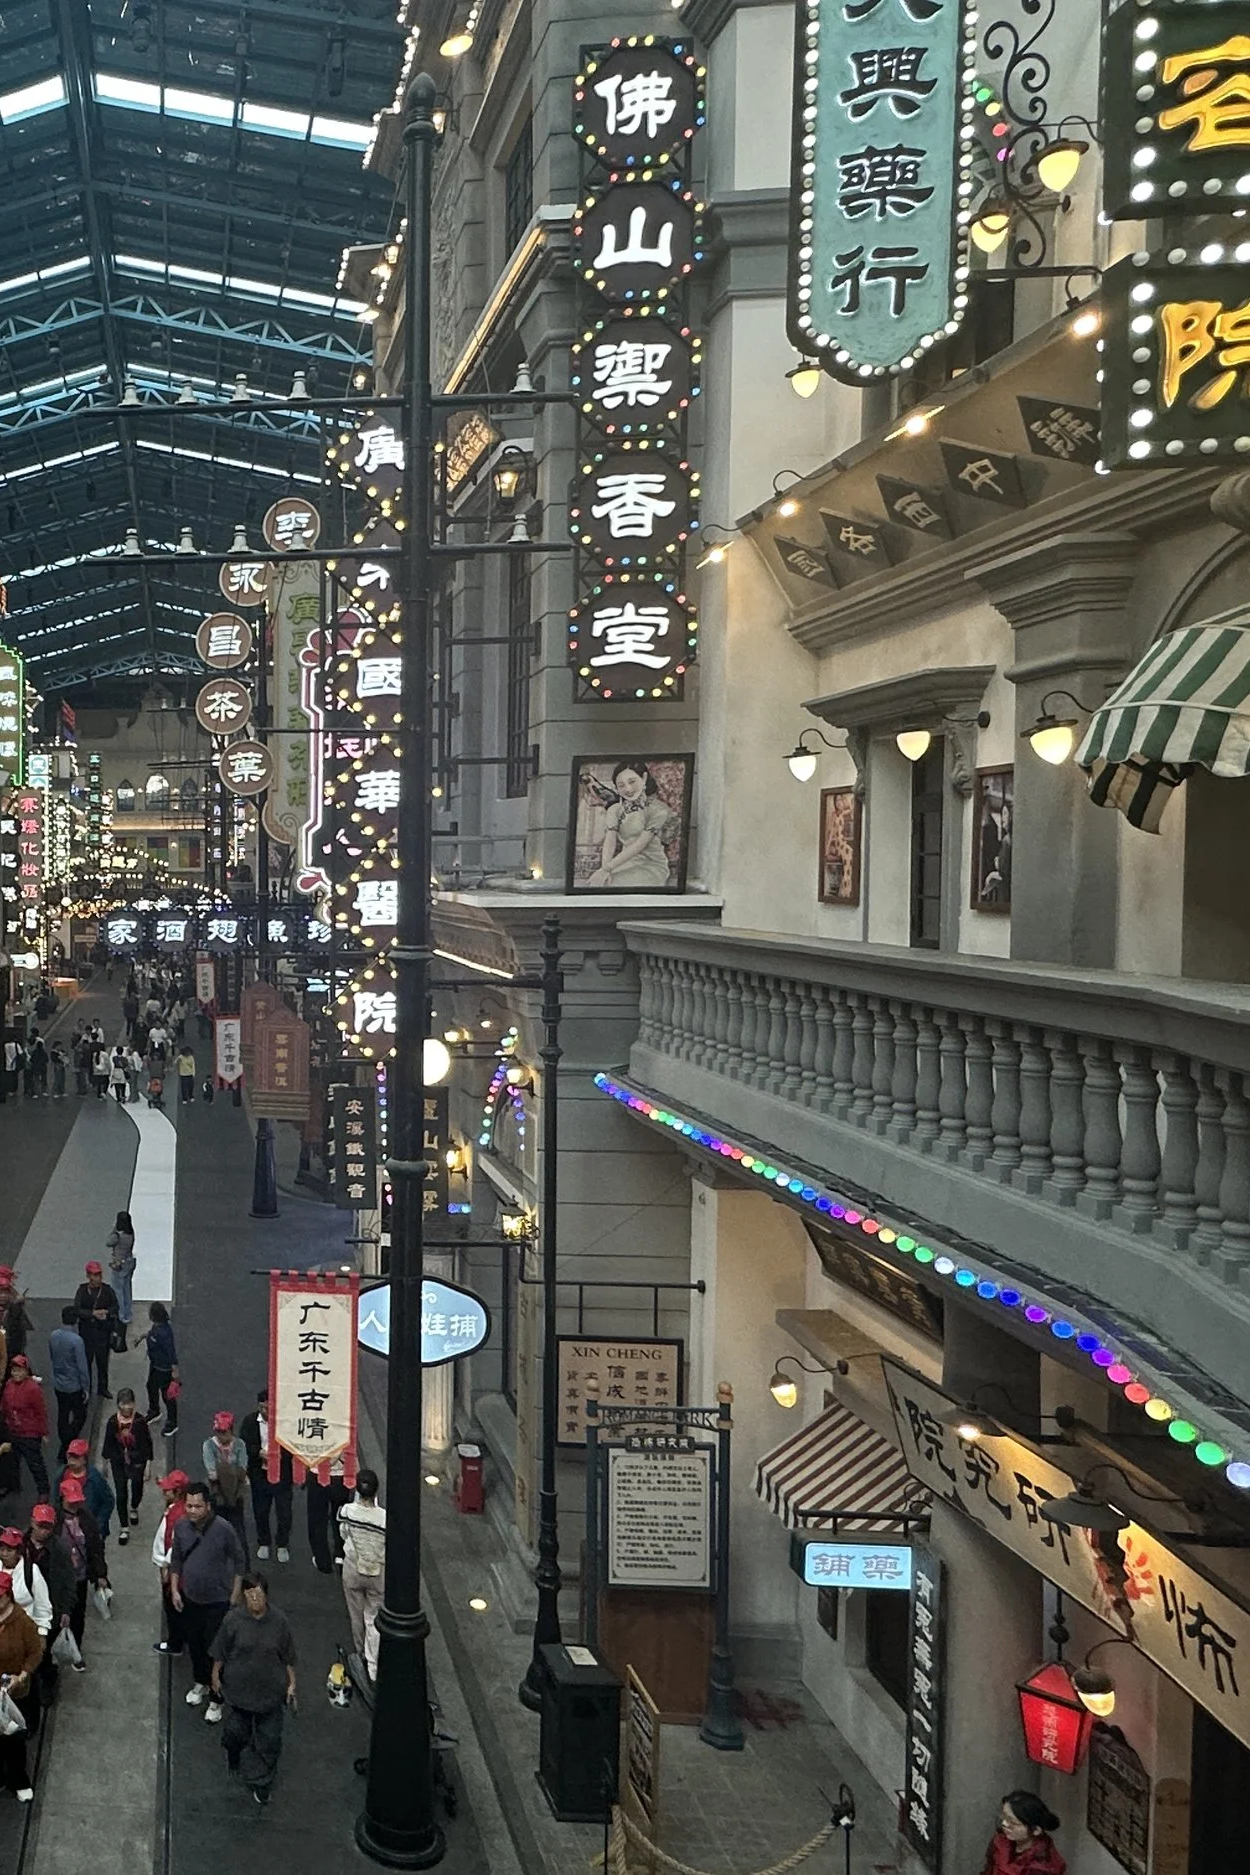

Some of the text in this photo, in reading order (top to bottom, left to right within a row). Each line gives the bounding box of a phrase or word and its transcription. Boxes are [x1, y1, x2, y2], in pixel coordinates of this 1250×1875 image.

[297, 1301, 331, 1441] 广东千古情
[572, 1346, 662, 1361] XIN CHENG
